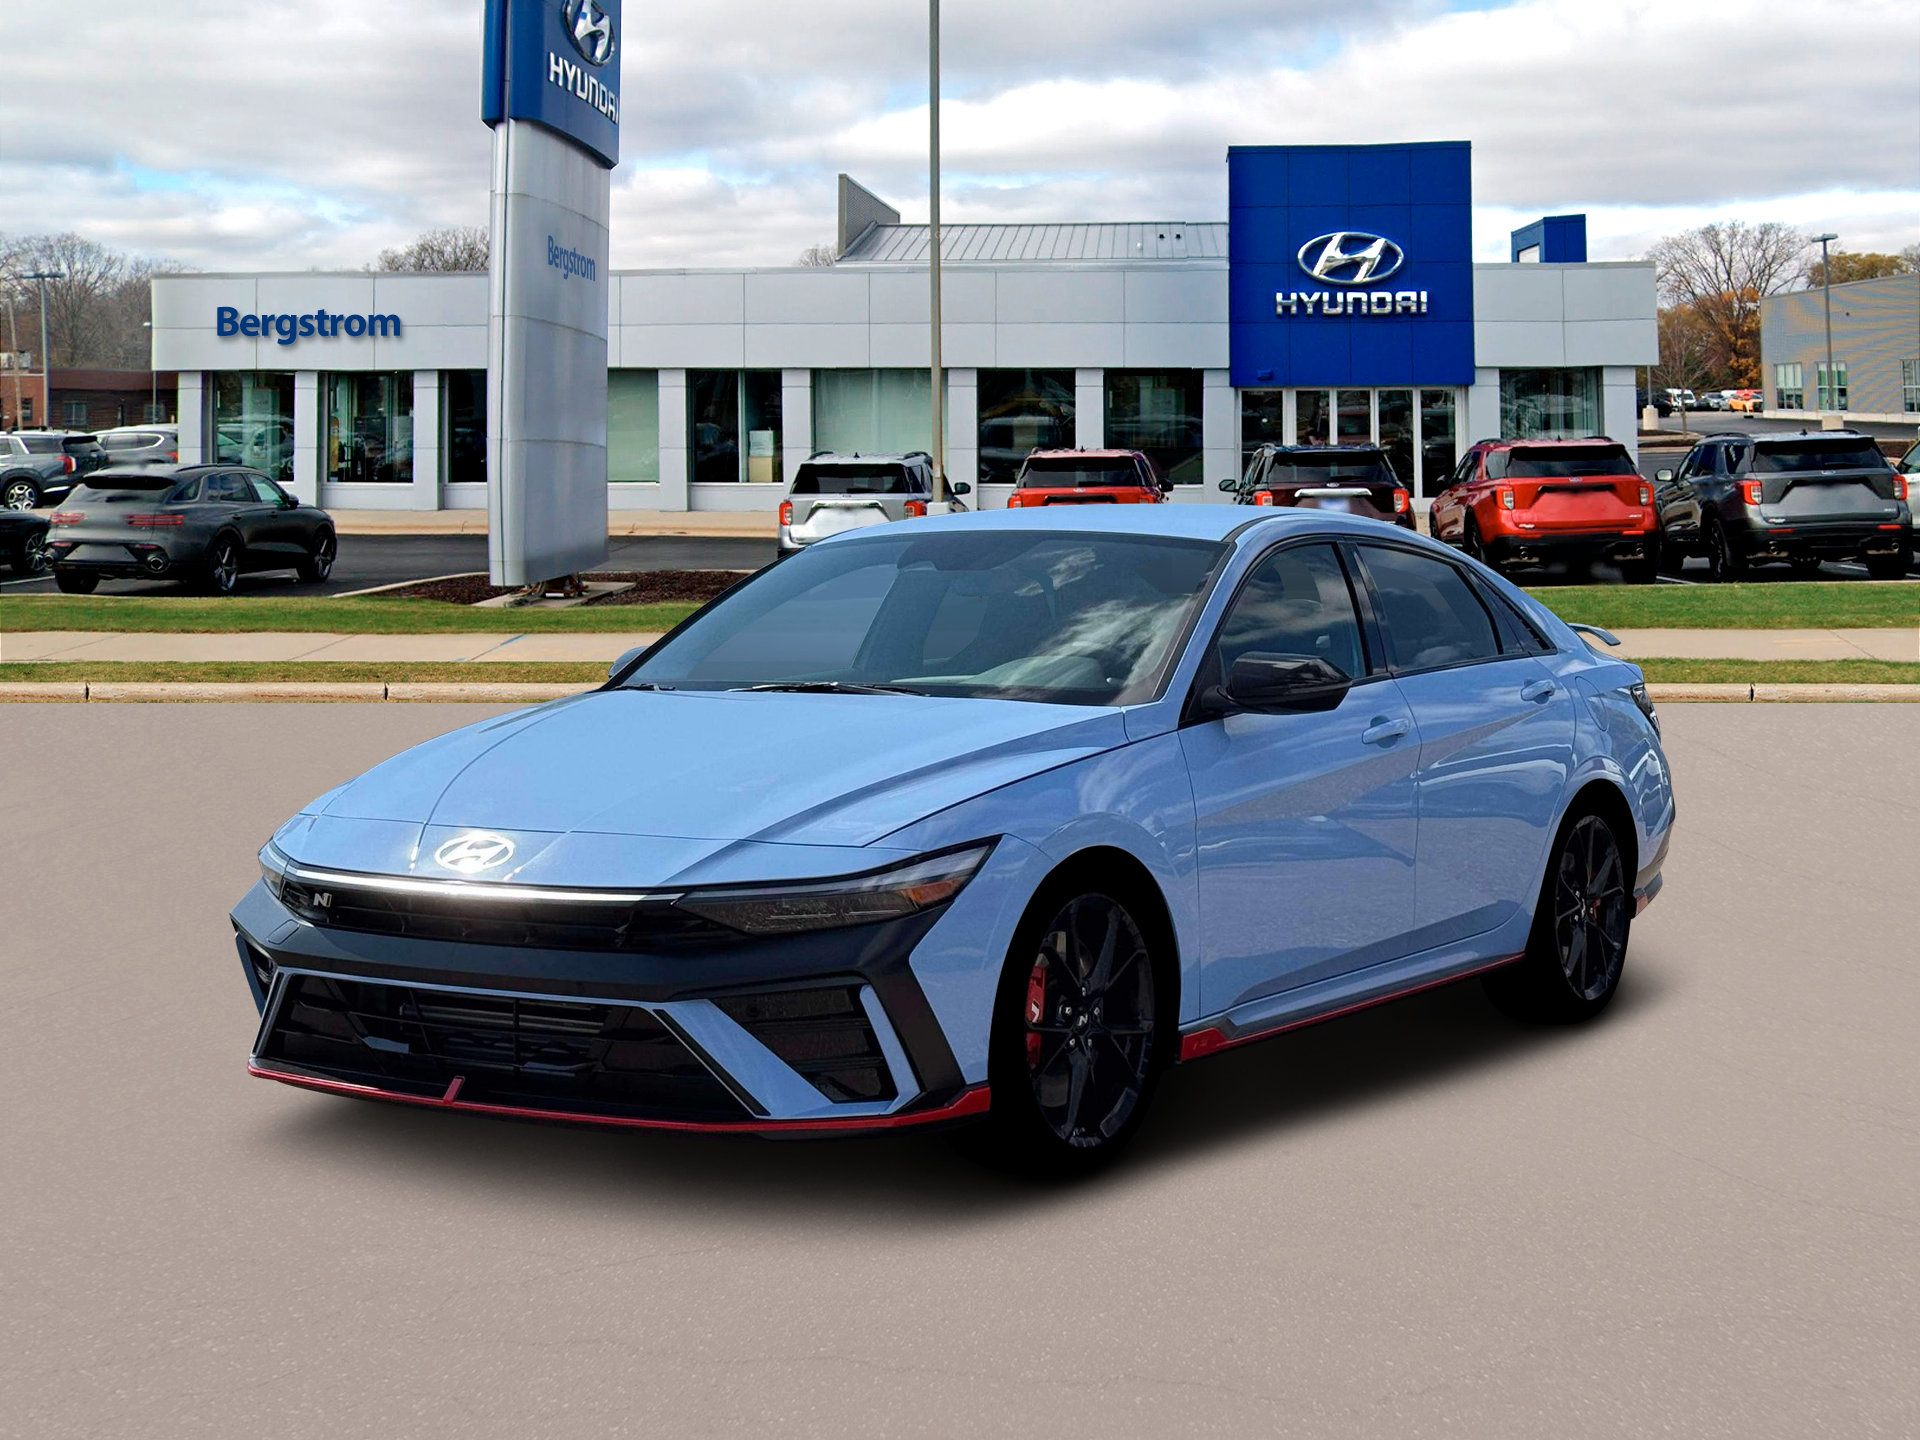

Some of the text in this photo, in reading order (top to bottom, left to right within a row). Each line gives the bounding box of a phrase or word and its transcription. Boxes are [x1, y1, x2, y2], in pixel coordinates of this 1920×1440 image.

[549, 51, 619, 124] HYUNDAI
[547, 235, 596, 282] Bergstrom
[1275, 291, 1428, 315] HYUNDAI
[216, 306, 402, 346] Bergstrom
